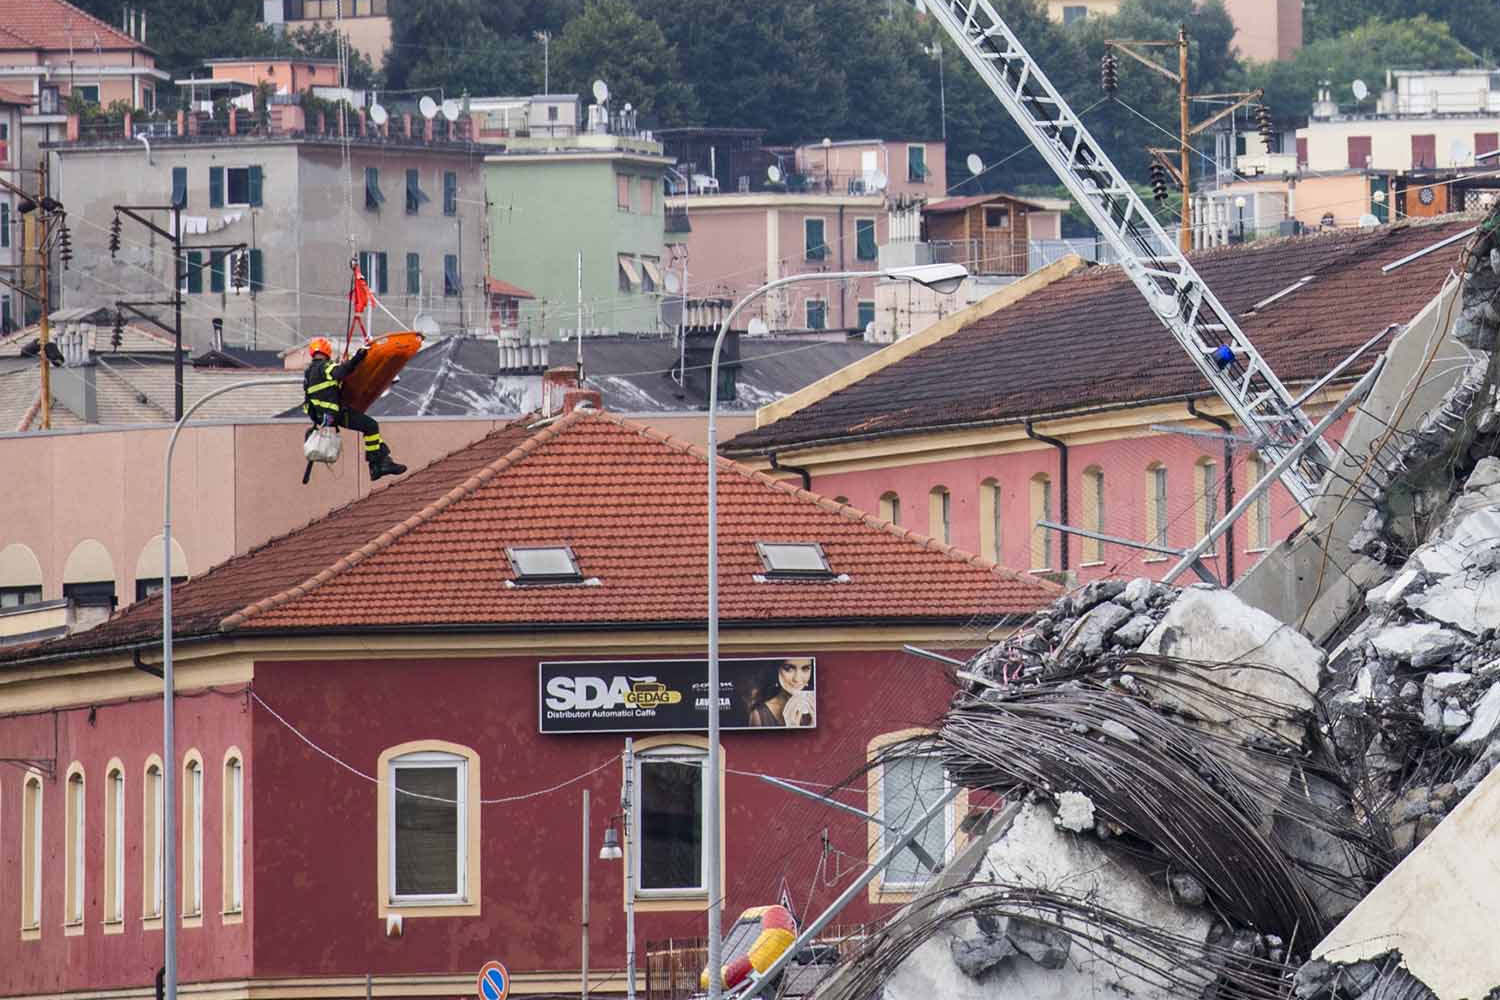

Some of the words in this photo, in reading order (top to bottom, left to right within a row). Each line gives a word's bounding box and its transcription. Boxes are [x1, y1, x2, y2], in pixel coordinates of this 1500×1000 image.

[546, 676, 638, 710] SDA
[627, 692, 670, 703] GEDAG
[547, 710, 590, 719] Distributori
[592, 709, 633, 718] Automatici
